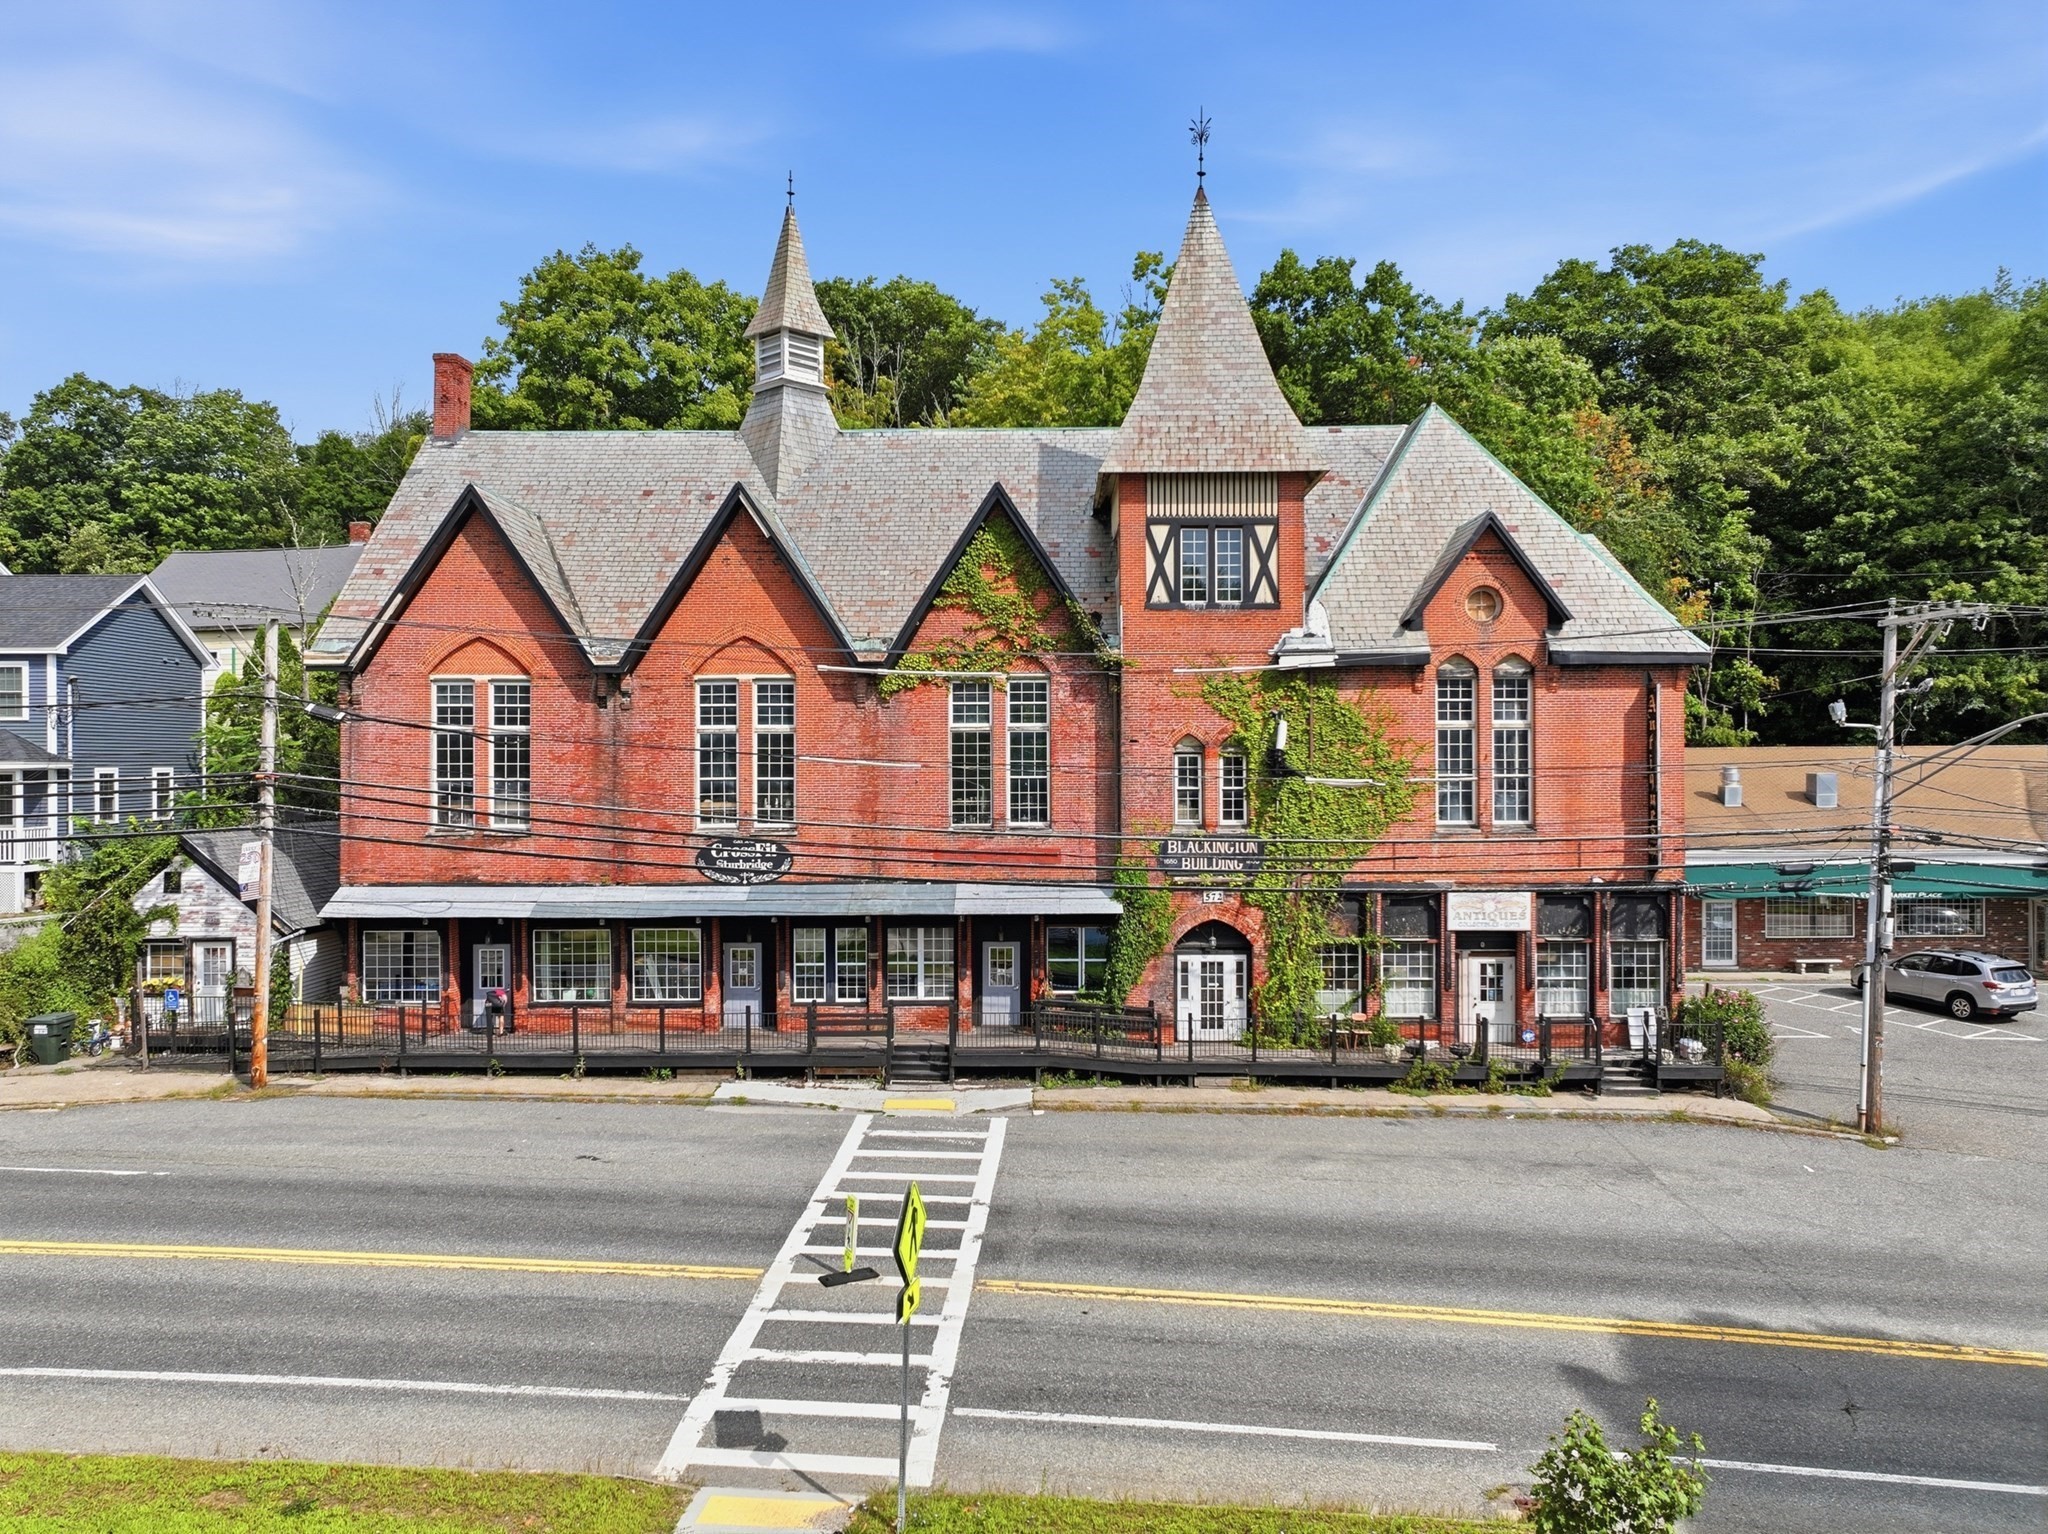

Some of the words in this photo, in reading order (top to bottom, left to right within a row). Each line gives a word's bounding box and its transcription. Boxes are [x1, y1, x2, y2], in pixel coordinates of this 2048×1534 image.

[711, 842, 777, 858] CrossFit
[1167, 840, 1258, 854] BLACKINGTON
[716, 859, 774, 870] Sturbridge
[1181, 857, 1244, 870] BUILDING
[1205, 893, 1222, 901] 572
[1453, 911, 1527, 922] ANTIQUES
